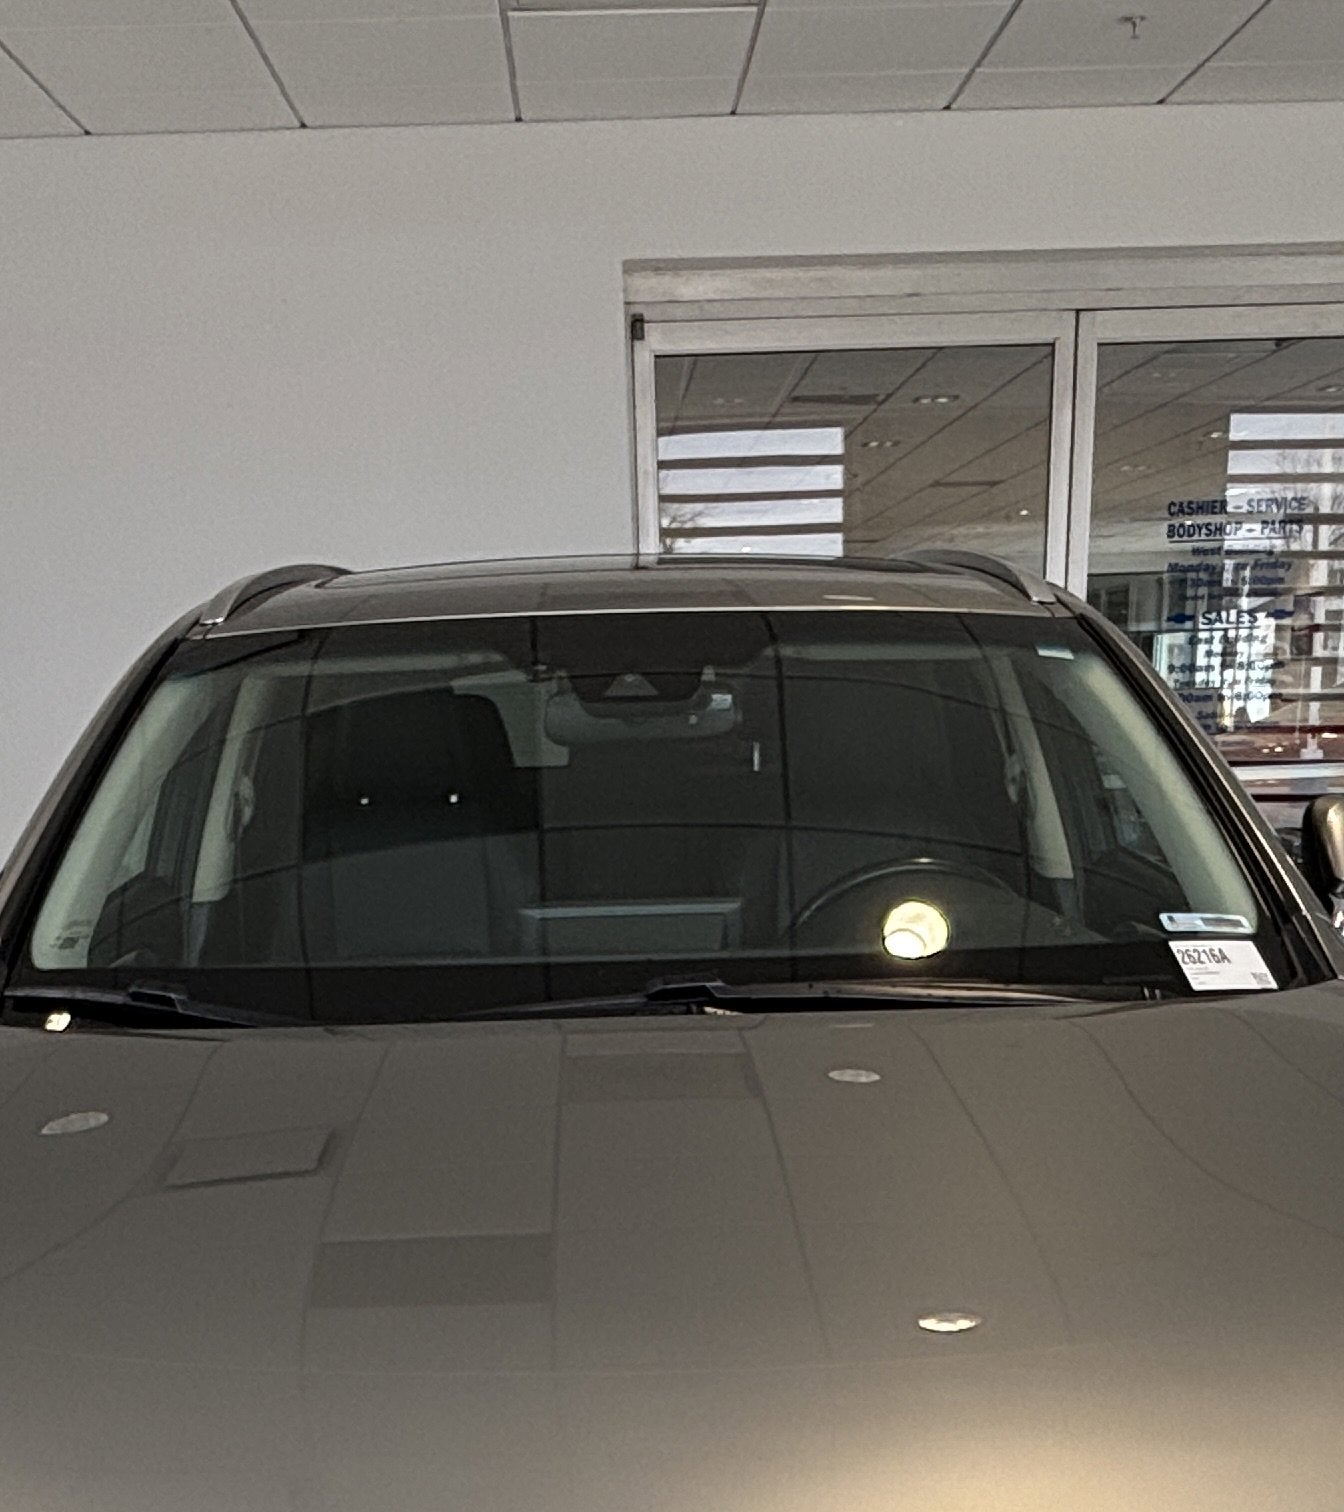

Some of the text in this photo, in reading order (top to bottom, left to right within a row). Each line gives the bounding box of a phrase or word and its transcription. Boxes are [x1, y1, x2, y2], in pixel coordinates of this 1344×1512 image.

[1167, 496, 1308, 517] CASHIER SERVICE
[1166, 519, 1304, 539] BODYSHOP PARTS
[1201, 609, 1259, 626] SALES
[1176, 947, 1232, 965] 26216A
